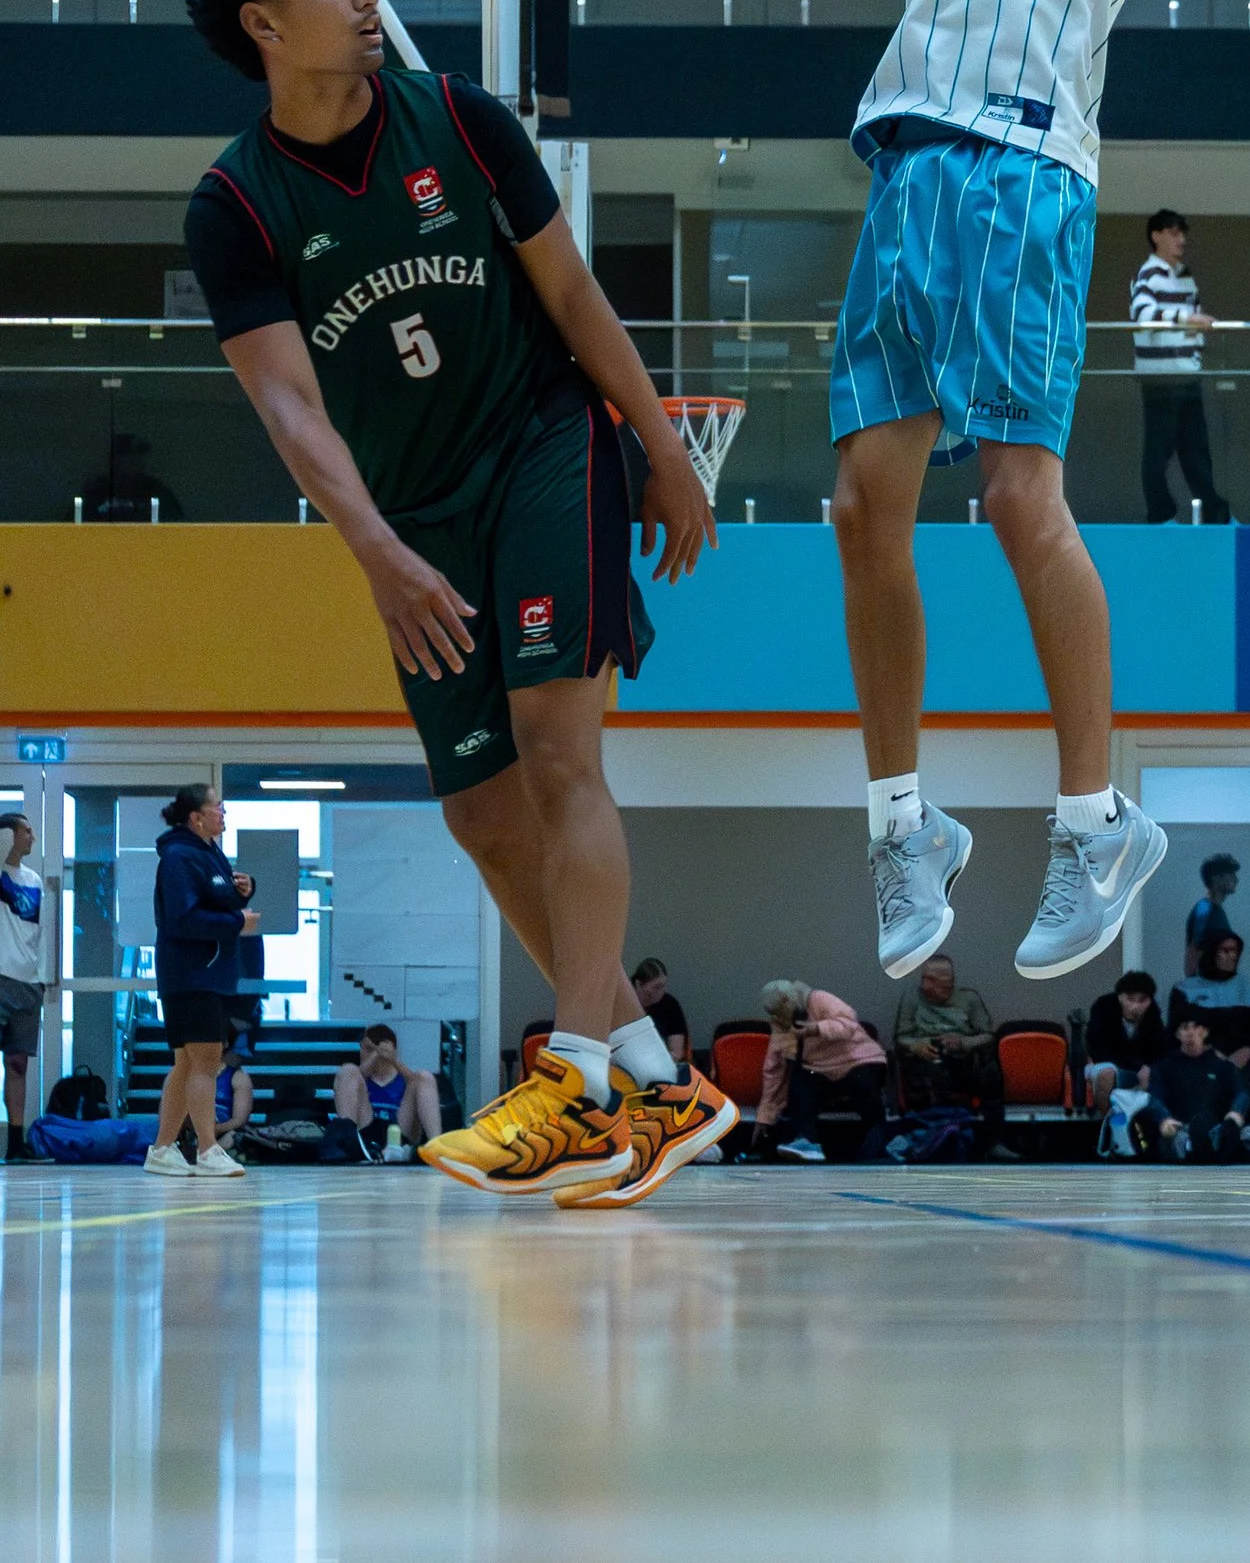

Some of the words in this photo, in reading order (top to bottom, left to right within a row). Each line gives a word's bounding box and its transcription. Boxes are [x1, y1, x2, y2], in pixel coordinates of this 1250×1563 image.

[311, 255, 486, 352] ONEHUNGA
[389, 311, 442, 379] 5
[967, 397, 1029, 422] Kristin
